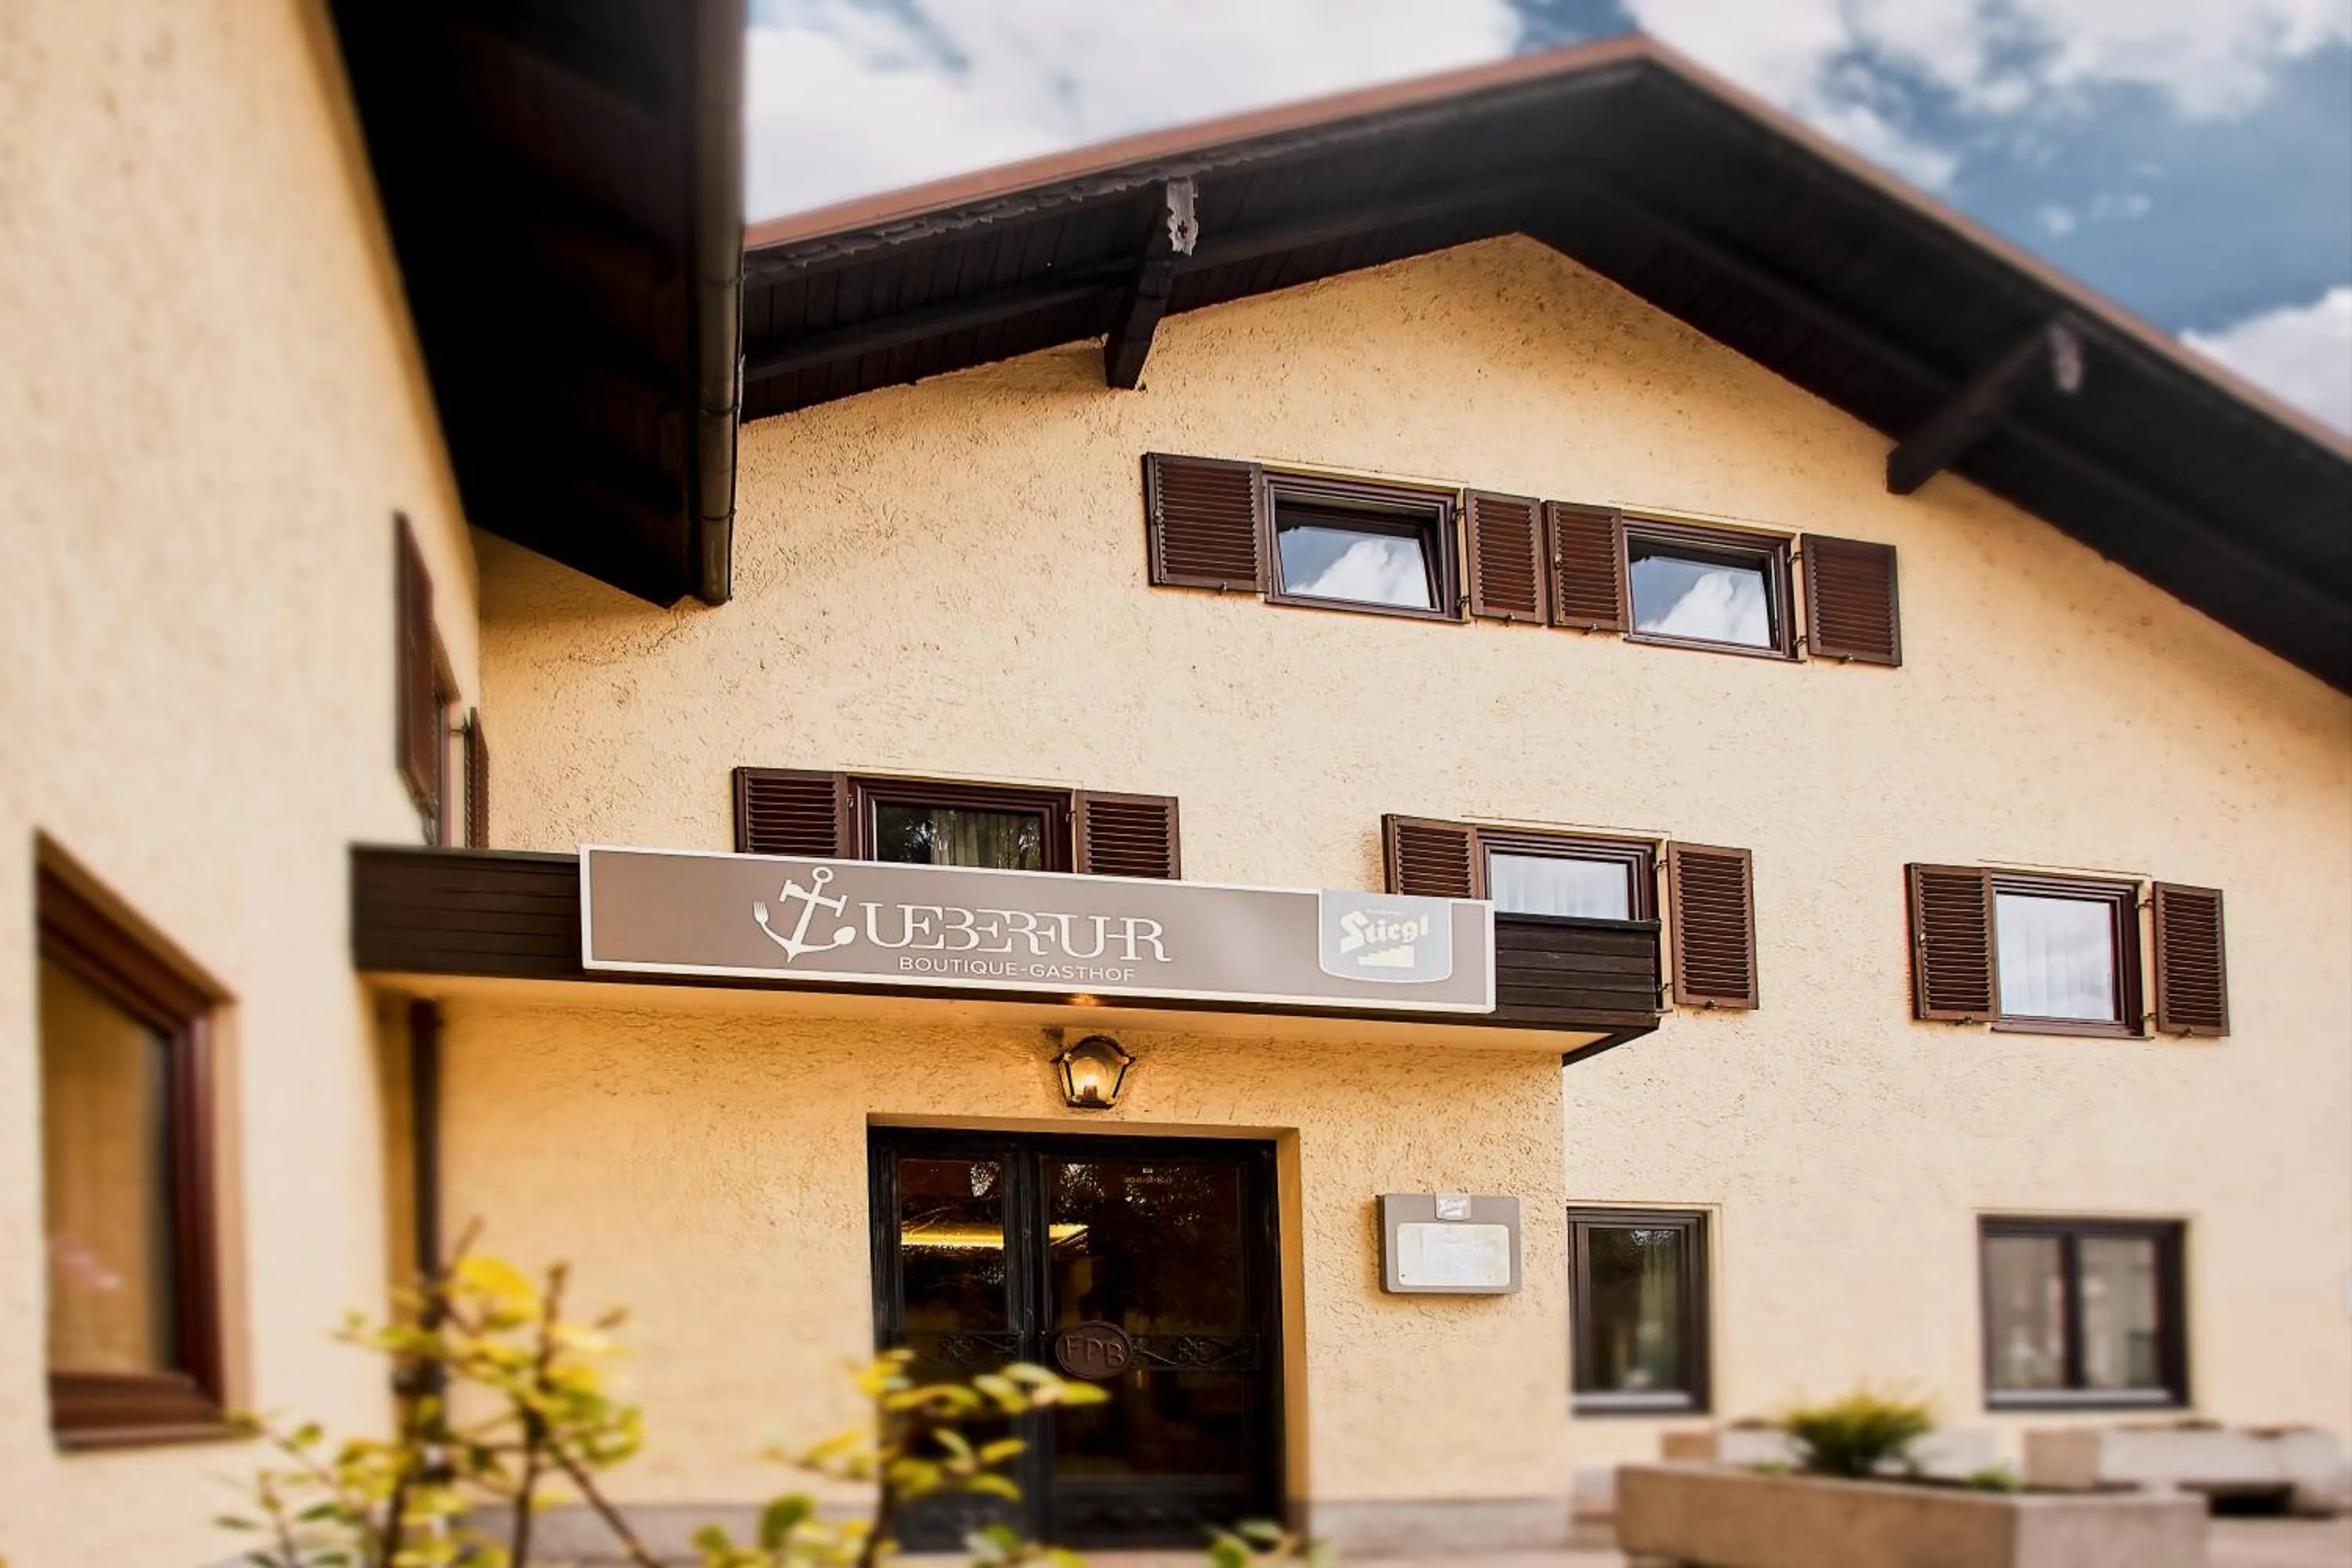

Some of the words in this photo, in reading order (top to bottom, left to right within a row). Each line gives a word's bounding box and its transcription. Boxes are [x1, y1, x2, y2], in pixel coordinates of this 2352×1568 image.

[858, 902, 1172, 963] UEBERFUHR
[1339, 910, 1430, 954] Stiegl
[898, 956, 1135, 982] BOUTIQUE-GASTHOF
[1065, 1334, 1126, 1368] FPB
